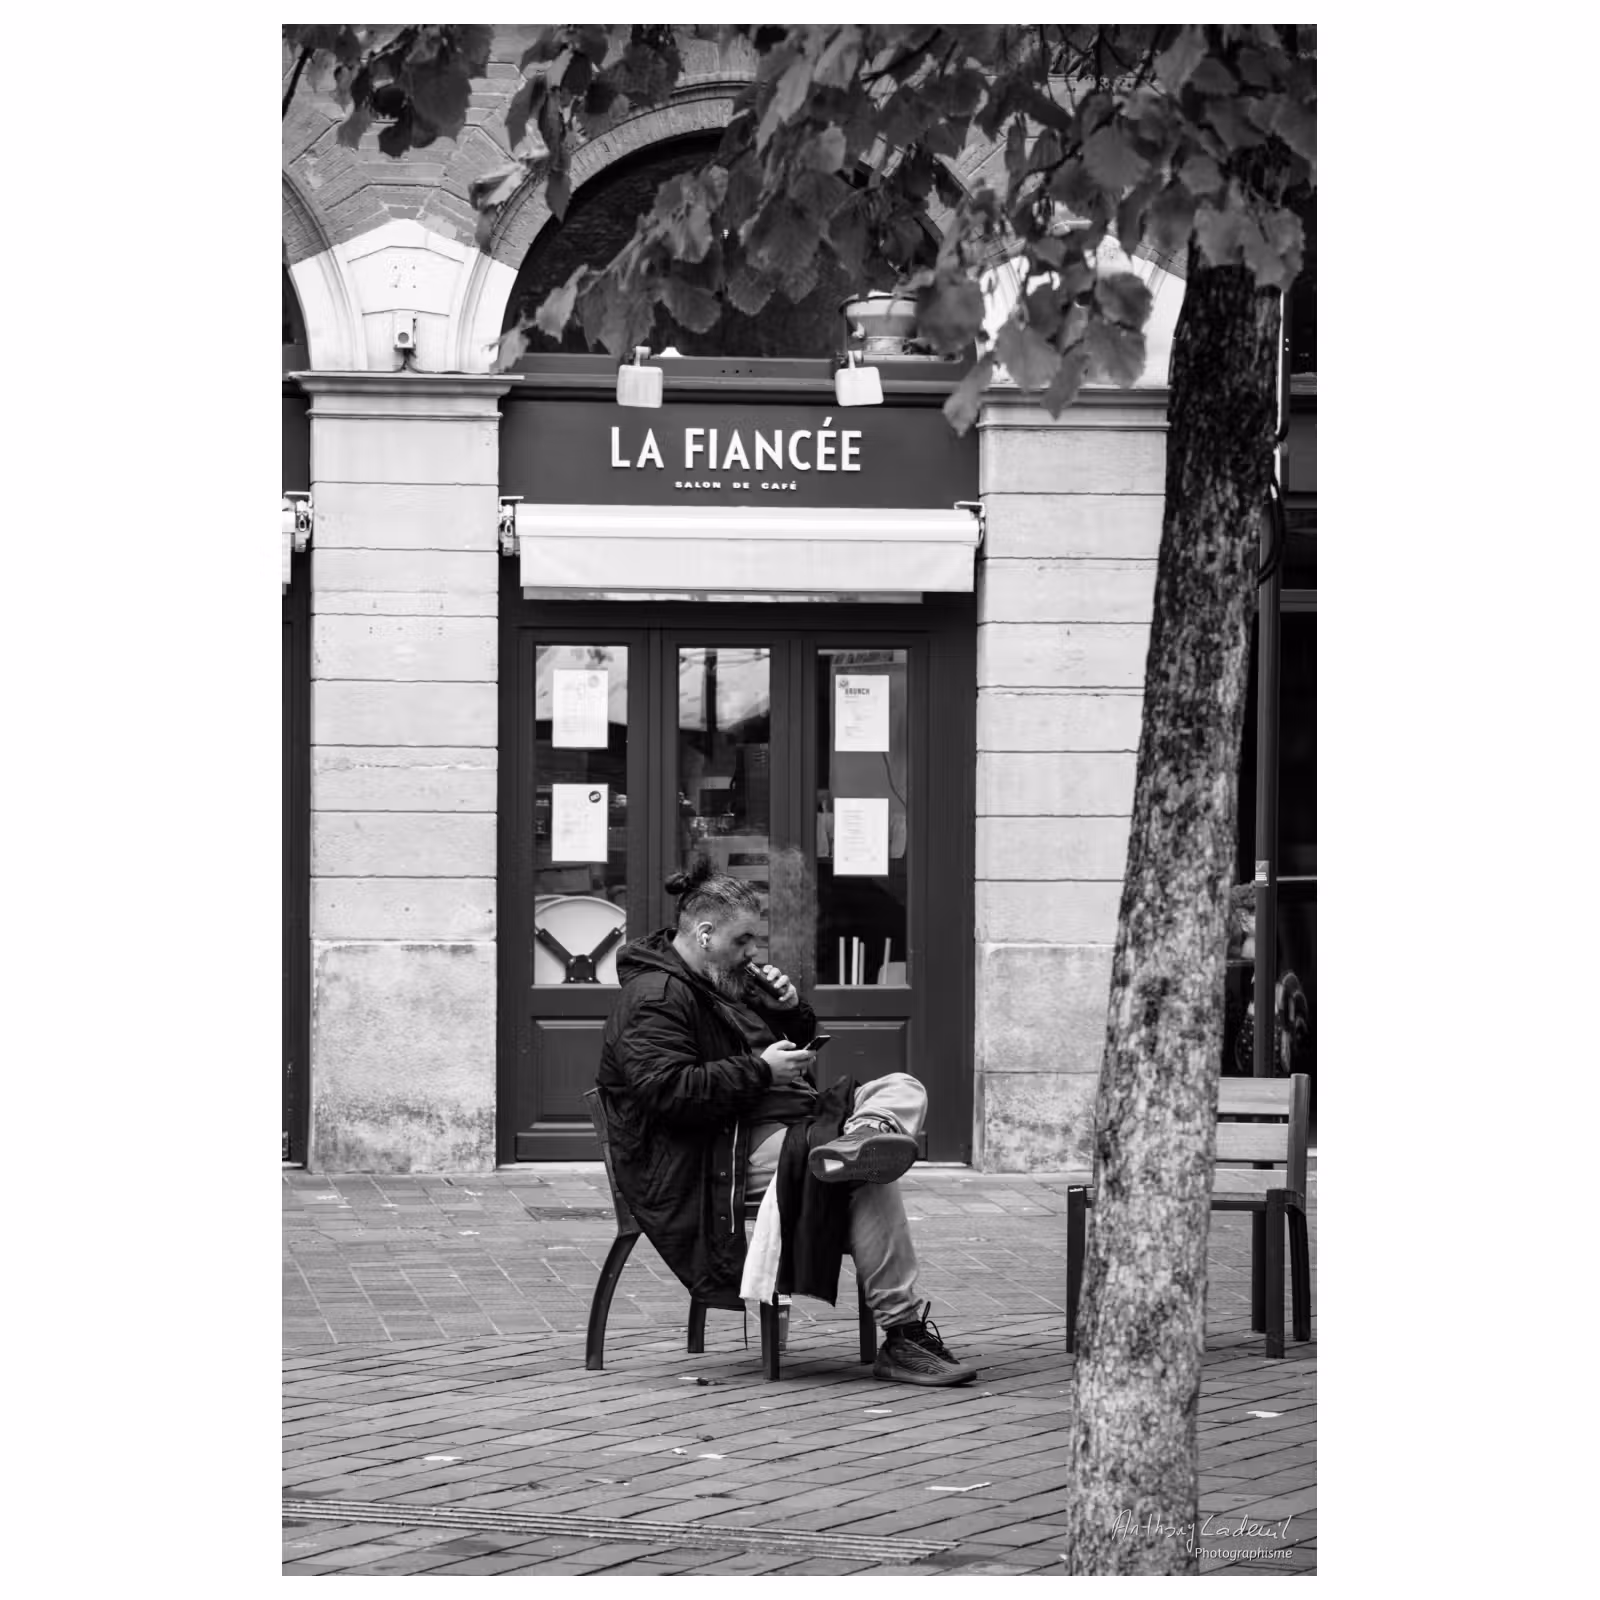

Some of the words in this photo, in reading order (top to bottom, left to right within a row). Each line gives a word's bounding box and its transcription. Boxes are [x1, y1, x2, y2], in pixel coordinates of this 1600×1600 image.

[611, 426, 665, 468] LA
[685, 416, 862, 471] FIANCÉE
[675, 481, 722, 489] SALON
[761, 480, 797, 490] CAFÉ
